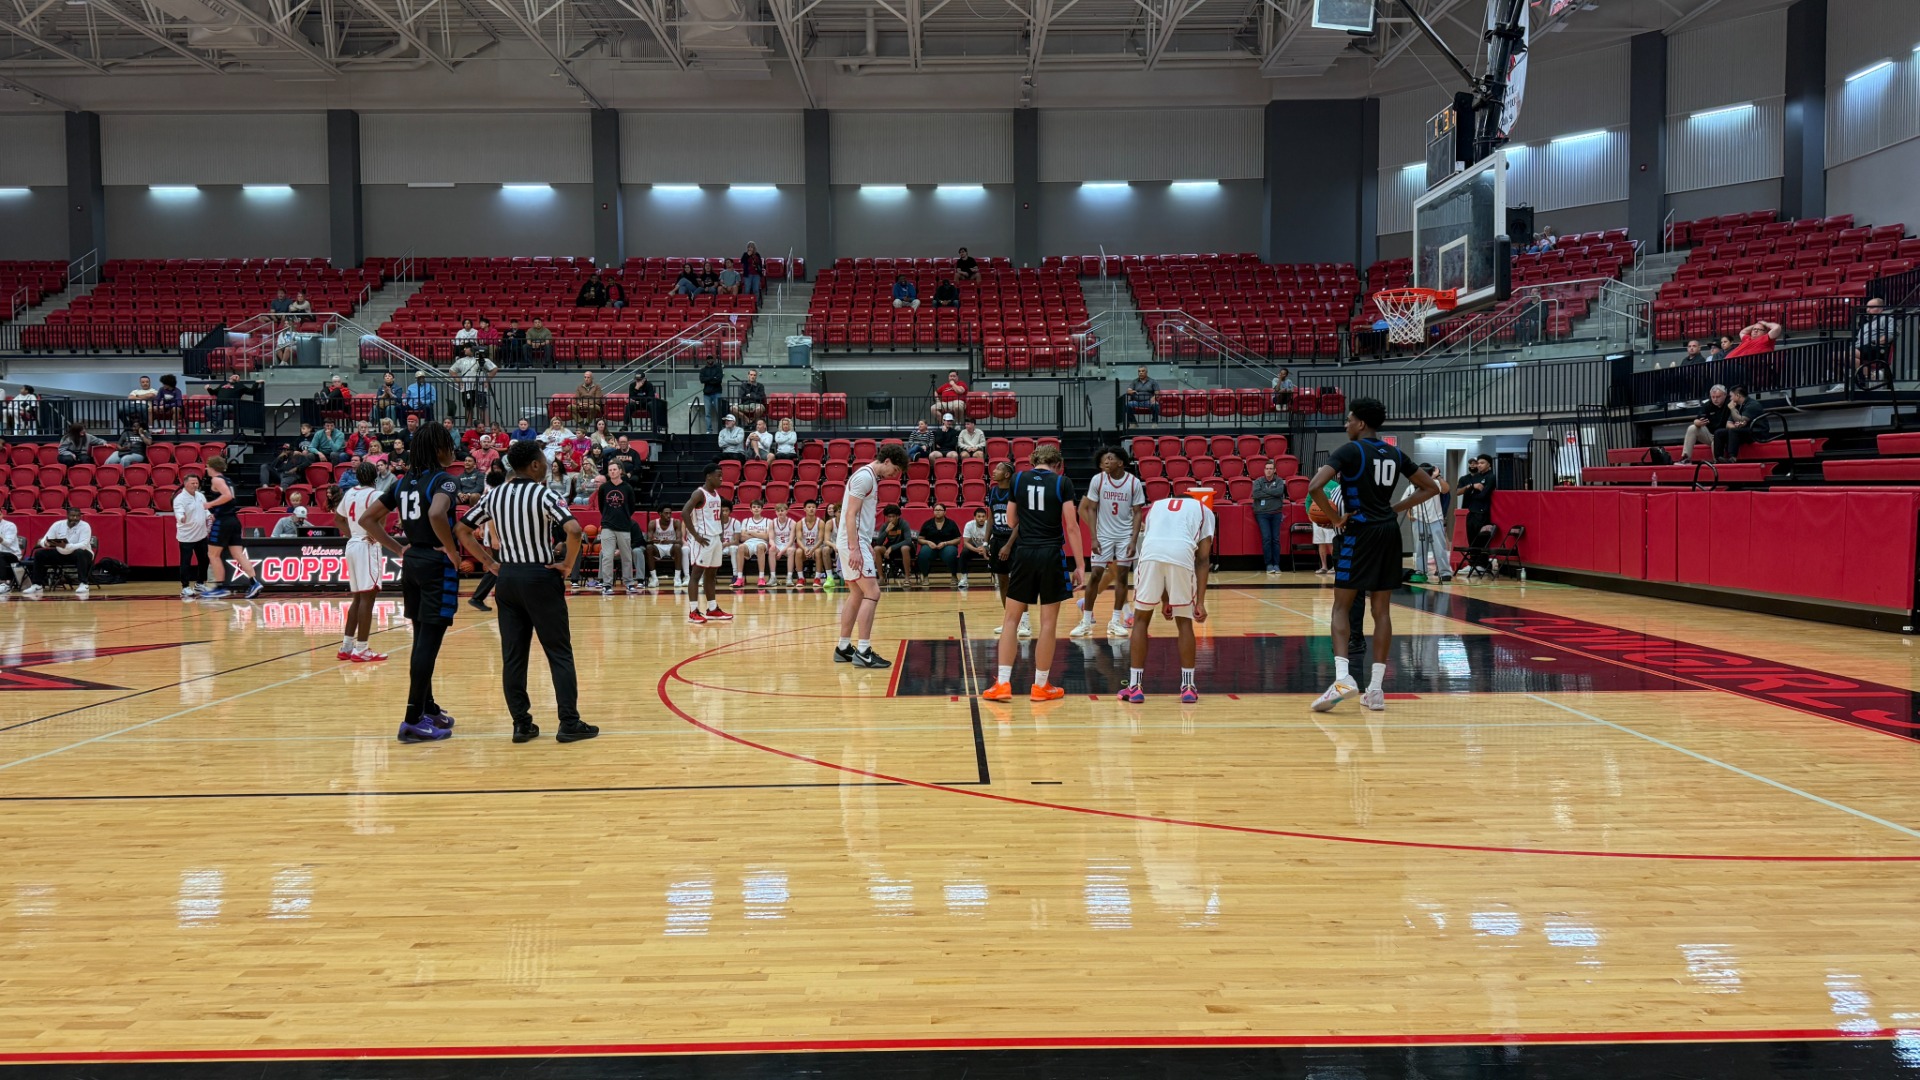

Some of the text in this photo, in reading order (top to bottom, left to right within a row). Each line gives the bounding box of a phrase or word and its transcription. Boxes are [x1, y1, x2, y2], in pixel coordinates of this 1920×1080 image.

[1373, 458, 1396, 487] 10
[1027, 485, 1045, 511] 11
[1103, 491, 1128, 502] COPPELL
[348, 501, 356, 522] 4
[400, 490, 421, 520] 13
[1111, 502, 1119, 516] 3
[1167, 499, 1183, 512] 0
[994, 512, 1007, 525] 20
[805, 538, 815, 546] 22
[301, 545, 343, 556] Welcome
